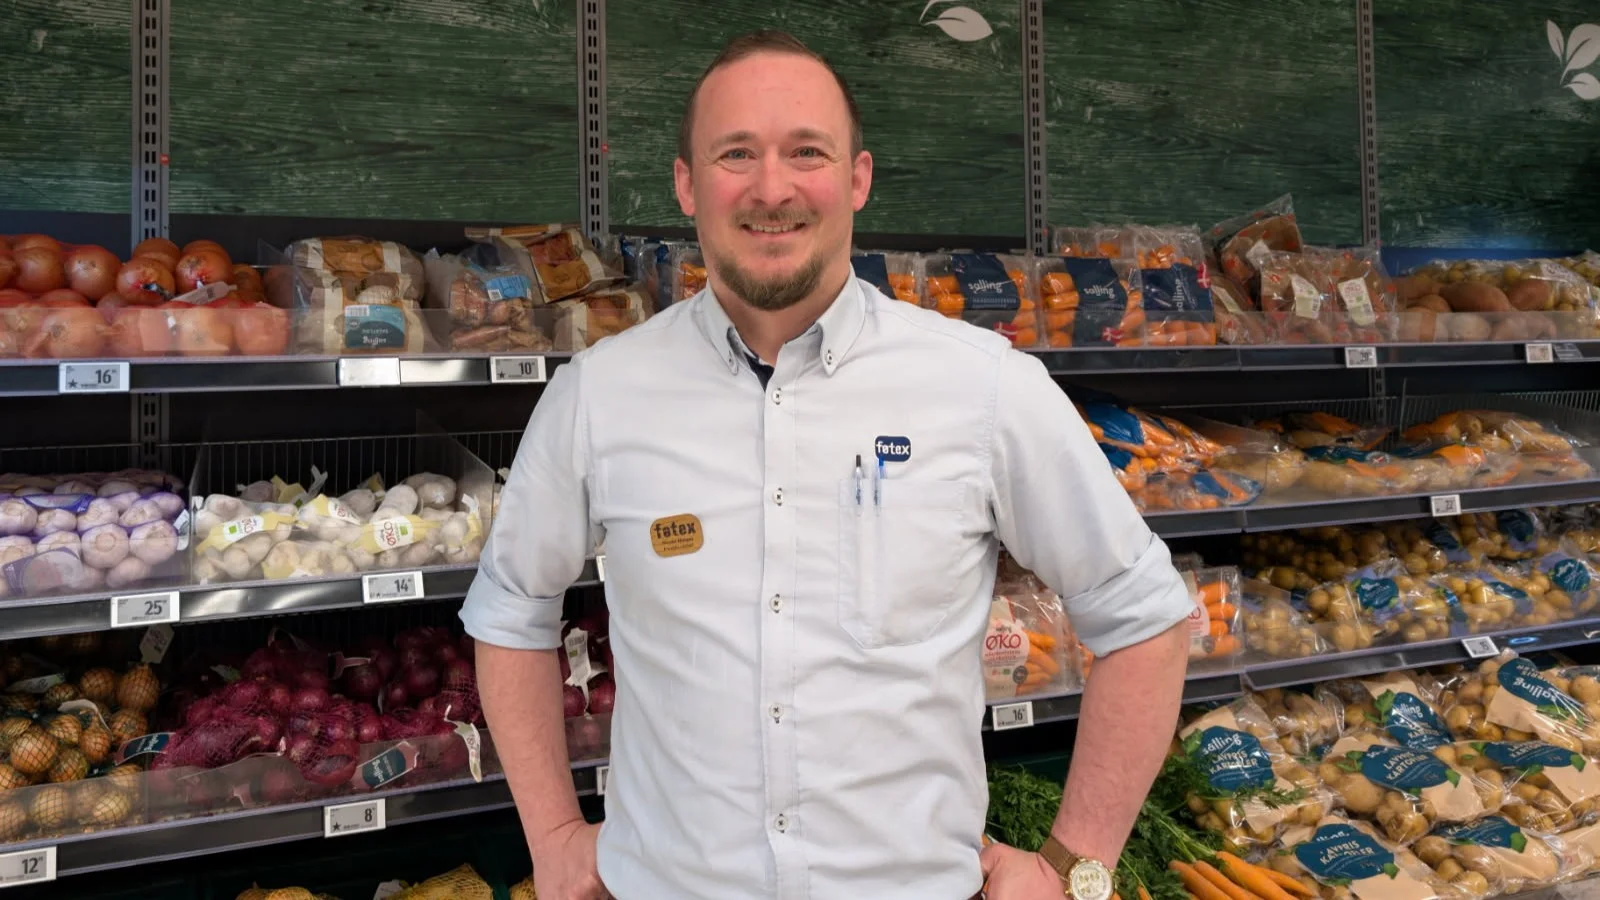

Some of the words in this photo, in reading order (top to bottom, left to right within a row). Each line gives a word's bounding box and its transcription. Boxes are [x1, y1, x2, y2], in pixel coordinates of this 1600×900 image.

[967, 279, 1003, 294] salling
[1083, 284, 1116, 299] salling
[519, 361, 532, 375] 10
[95, 369, 112, 384] 16
[394, 578, 409, 593] 14
[144, 600, 163, 616] 25
[986, 633, 1022, 651] ØKO
[1013, 708, 1023, 721] 16
[1202, 733, 1242, 756] salling
[364, 807, 373, 822] 8
[1320, 840, 1360, 856] AVPRIS
[21, 857, 39, 875] 12
